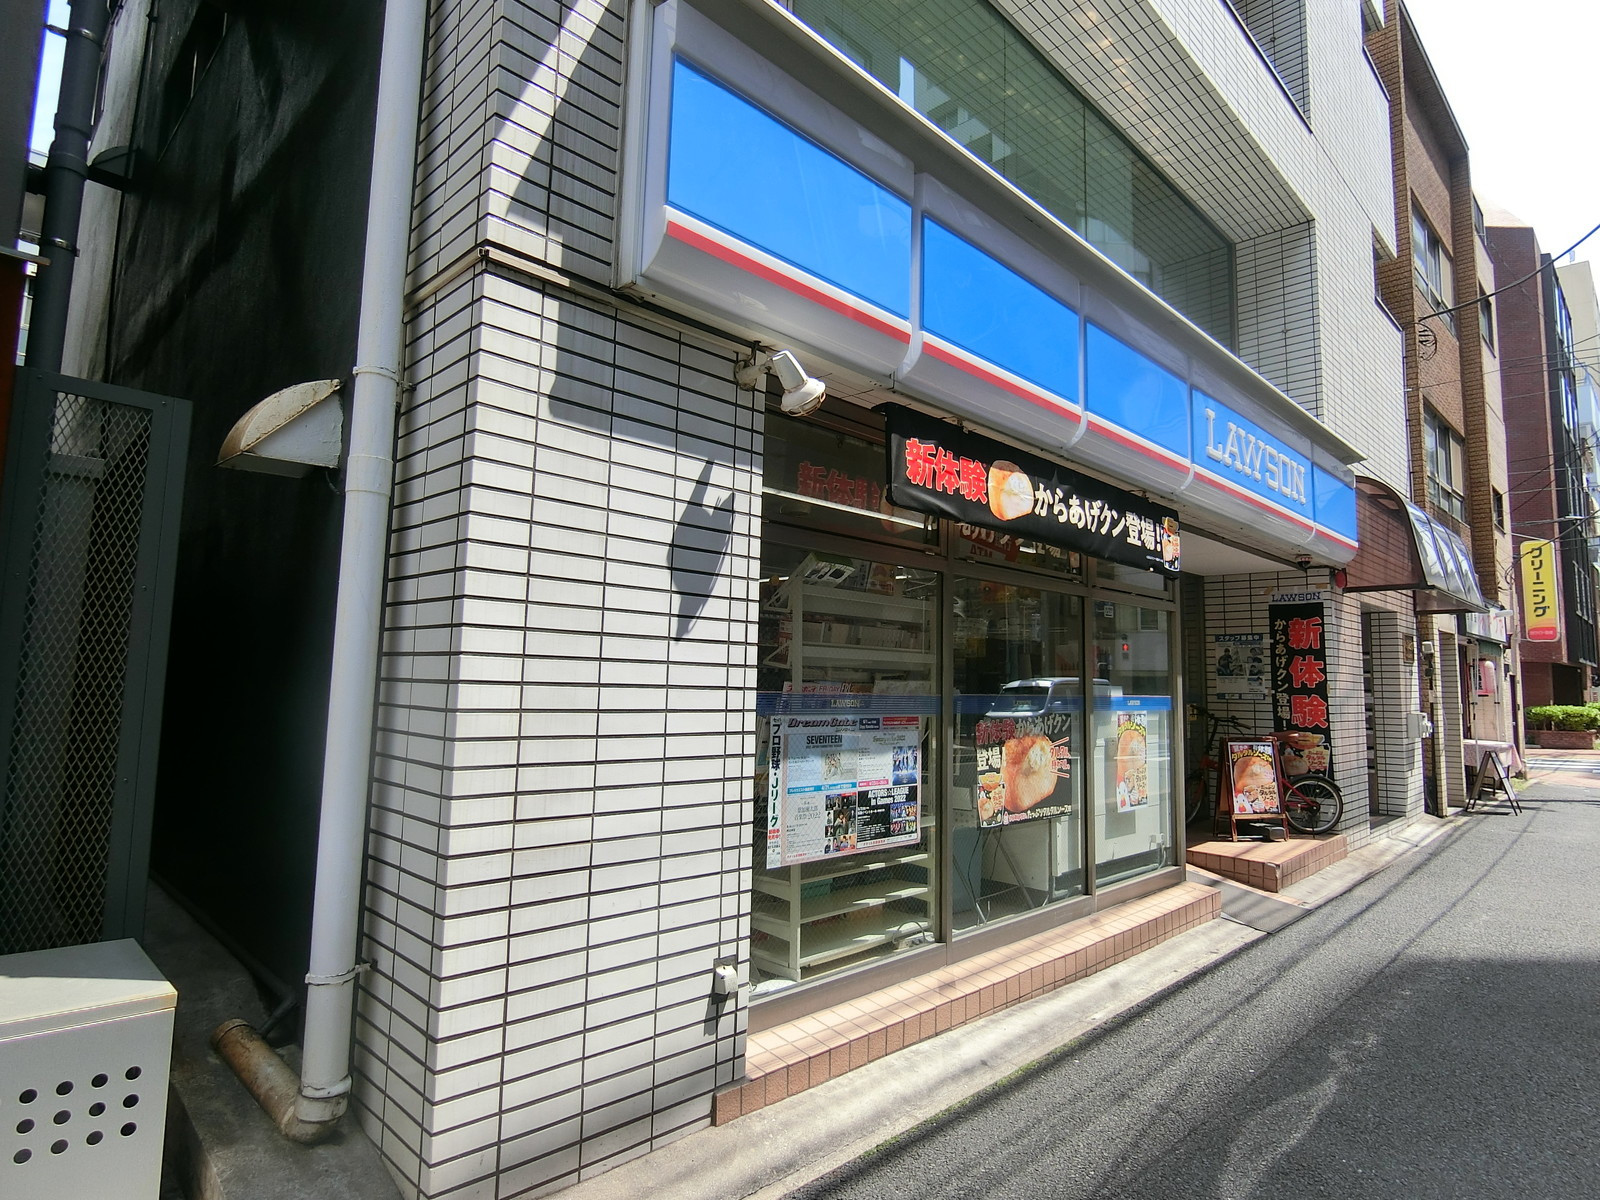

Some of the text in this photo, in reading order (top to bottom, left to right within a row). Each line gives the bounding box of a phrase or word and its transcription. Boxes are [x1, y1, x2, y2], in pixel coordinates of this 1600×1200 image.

[1205, 408, 1306, 505] LAWSON
[905, 437, 1162, 551] 新体験 からあげクン登場!
[1271, 591, 1321, 603] LAWSON
[1530, 547, 1550, 618] クリーニング
[1274, 619, 1291, 731] からあげクン登場!
[1288, 617, 1329, 729] 新体験
[831, 699, 860, 708] LAWSON
[1015, 713, 1071, 738] からあげクン
[806, 735, 843, 745] SEVENTEEN
[894, 794, 906, 803] 2022
